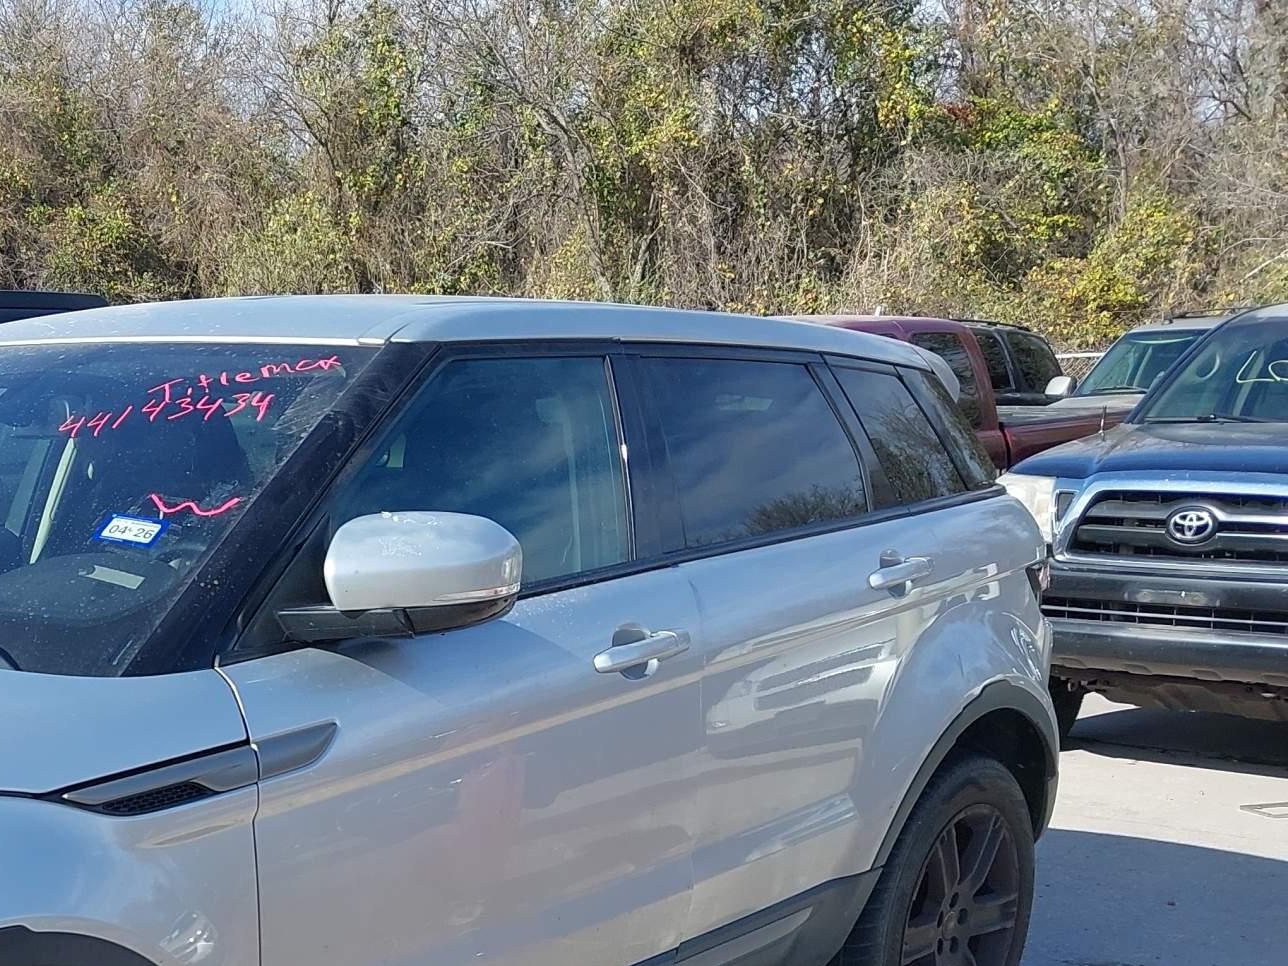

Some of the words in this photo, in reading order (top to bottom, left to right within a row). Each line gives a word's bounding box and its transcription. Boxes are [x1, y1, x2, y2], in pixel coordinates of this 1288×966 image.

[58, 391, 274, 438] 44143434
[108, 524, 128, 535] 04
[132, 527, 155, 540] 26
